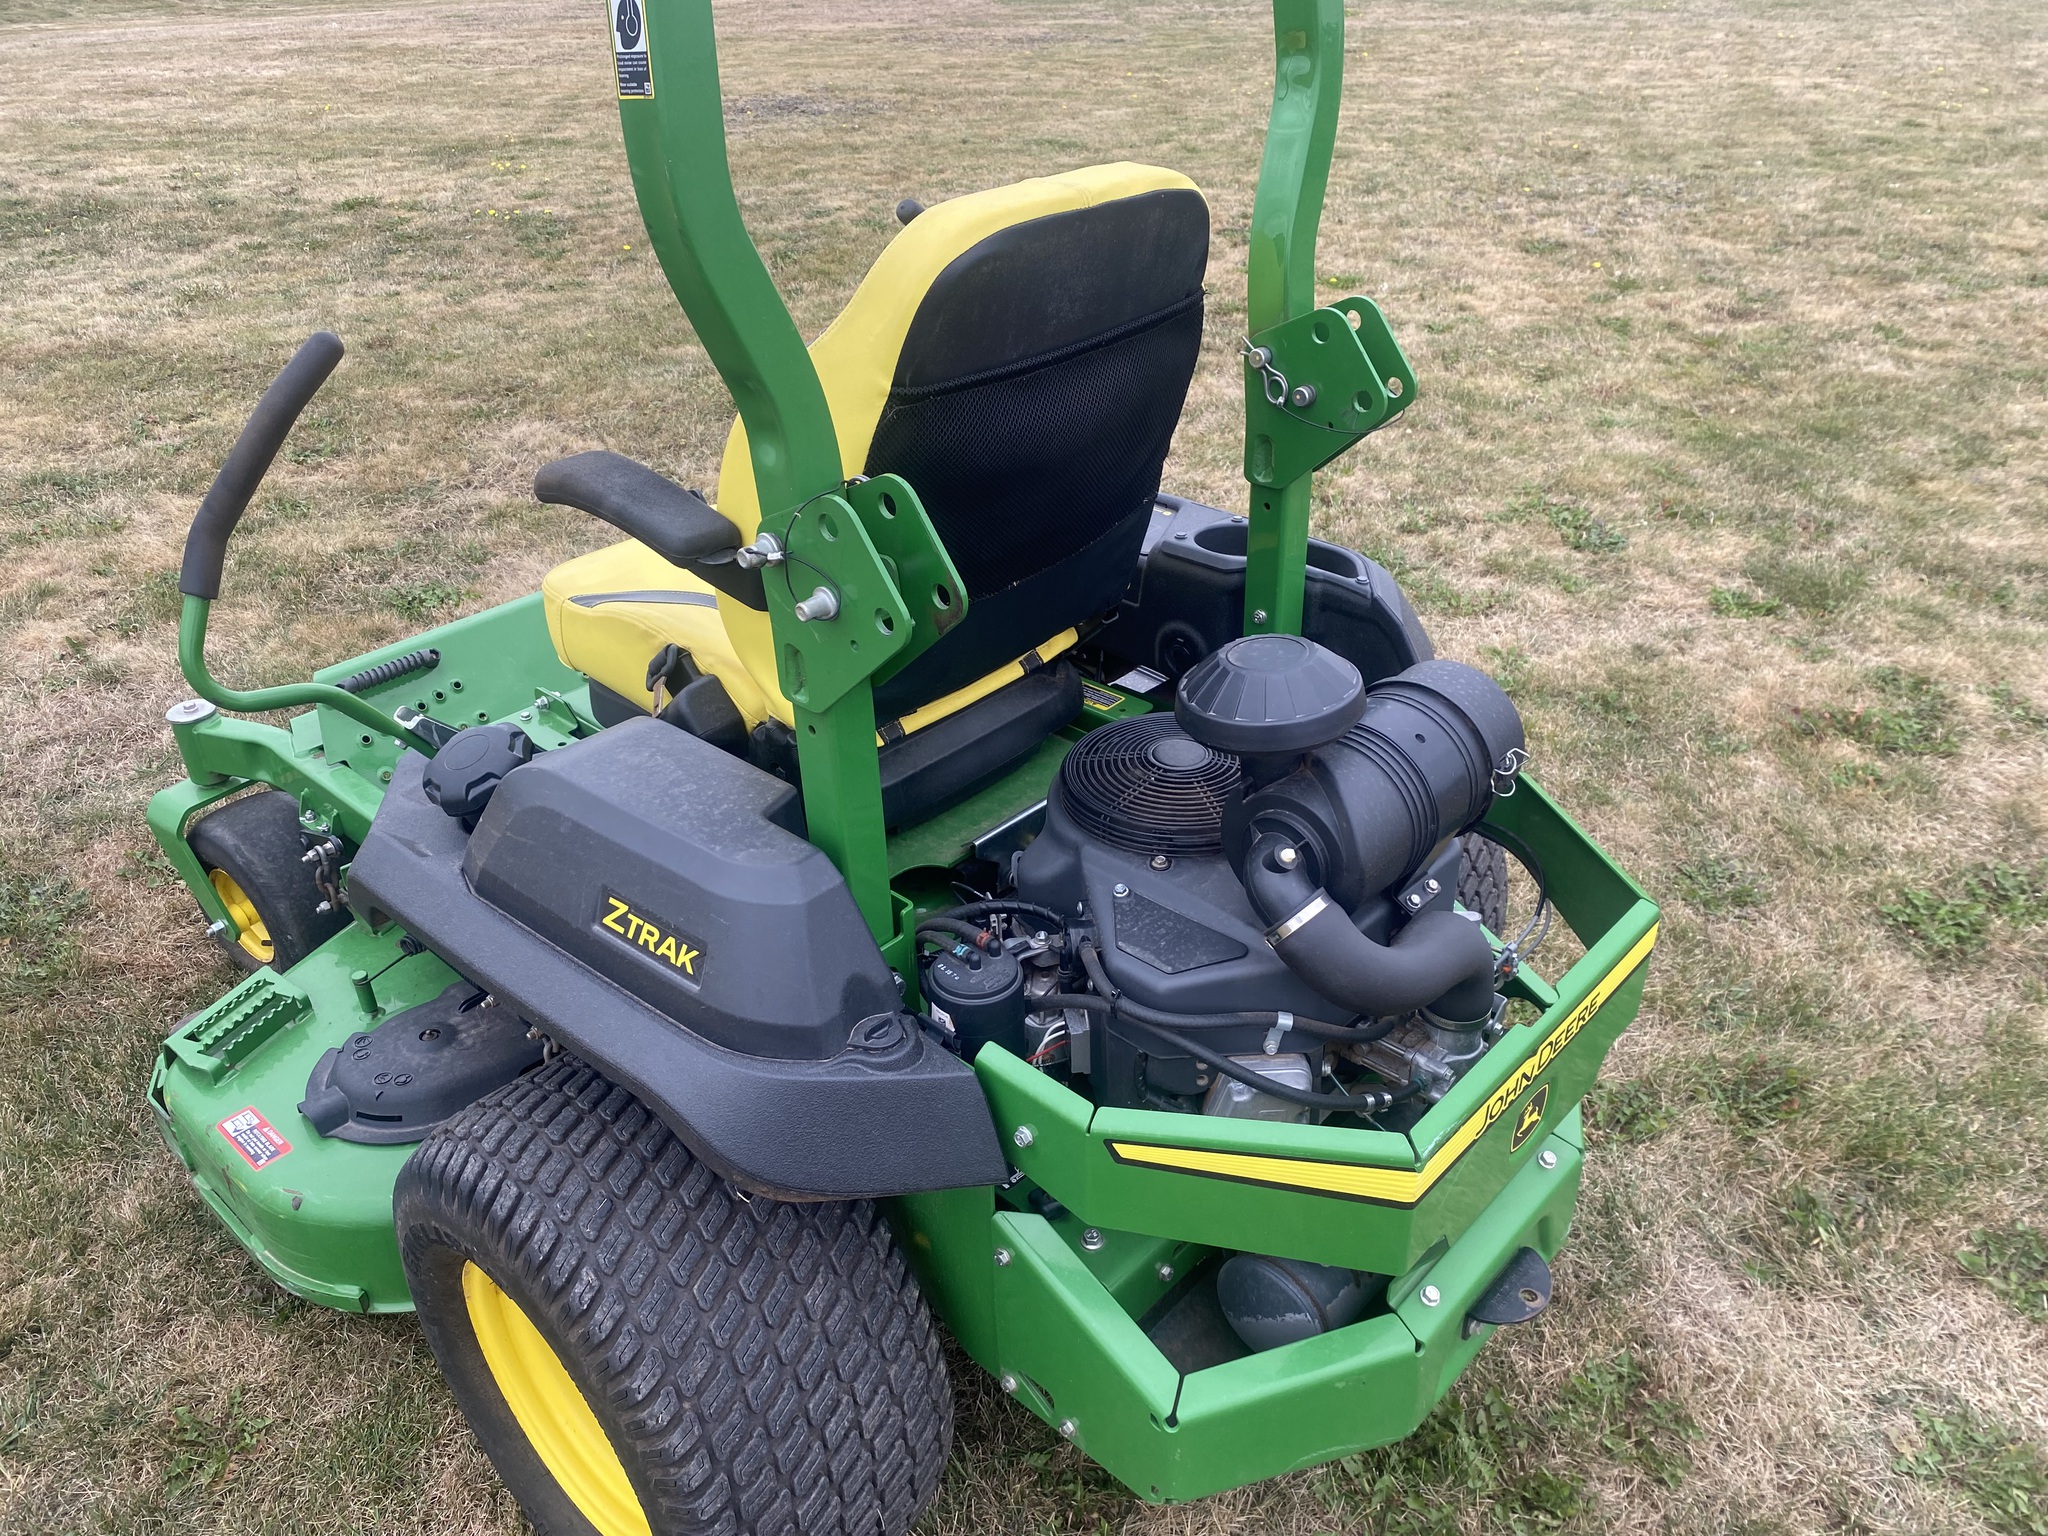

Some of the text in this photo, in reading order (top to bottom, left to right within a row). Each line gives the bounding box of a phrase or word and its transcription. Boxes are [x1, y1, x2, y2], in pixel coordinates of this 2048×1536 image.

[602, 896, 700, 975] ZTRAK
[1476, 991, 1601, 1137] JOHN DEERE
